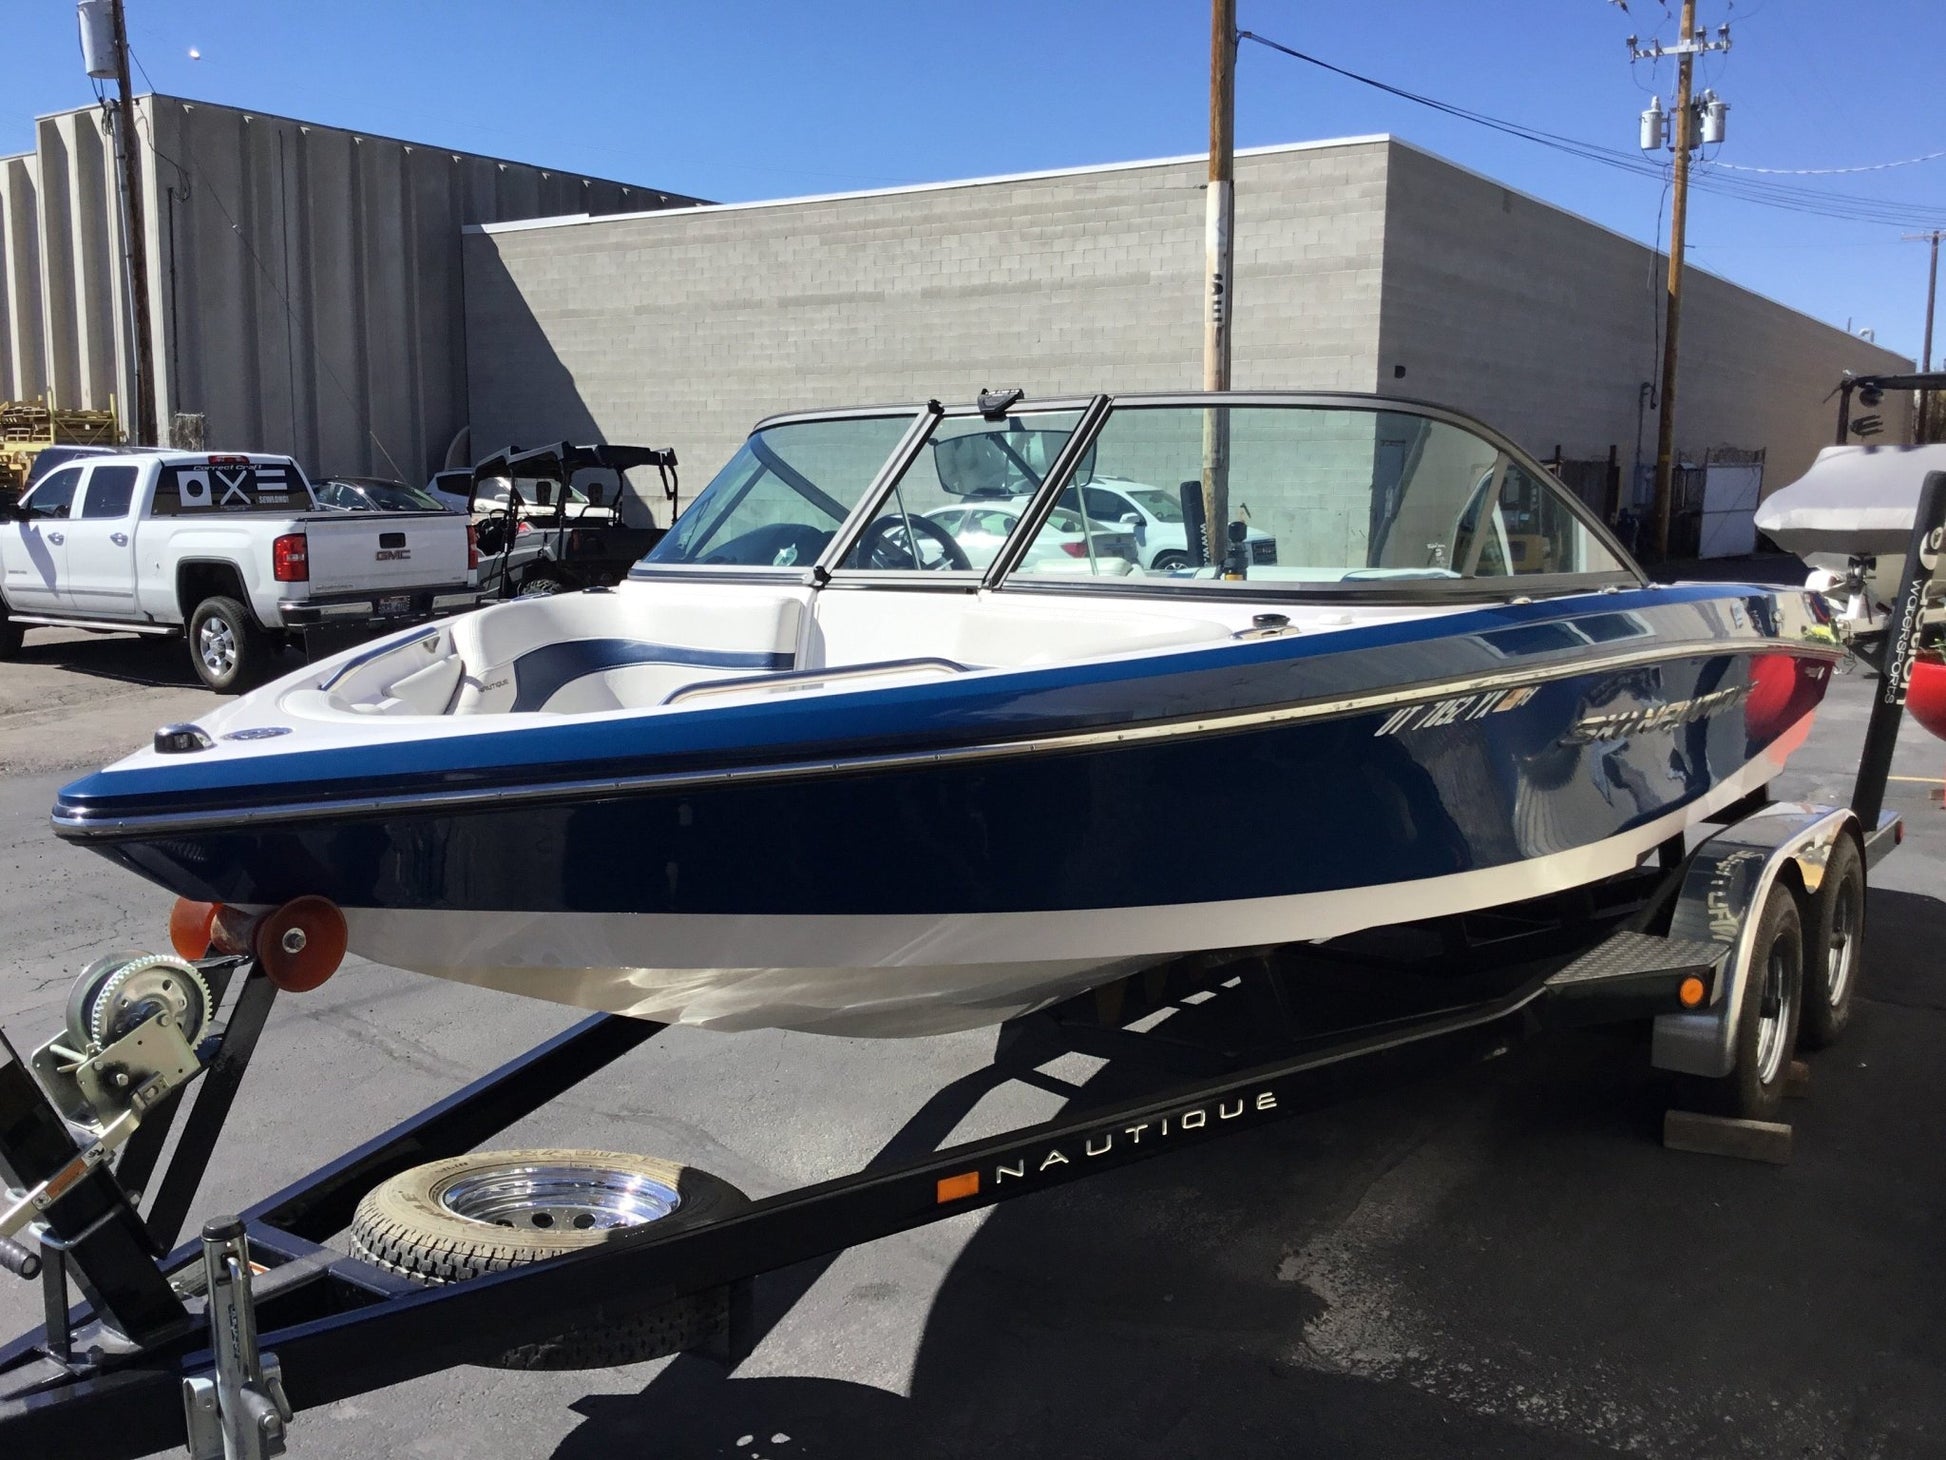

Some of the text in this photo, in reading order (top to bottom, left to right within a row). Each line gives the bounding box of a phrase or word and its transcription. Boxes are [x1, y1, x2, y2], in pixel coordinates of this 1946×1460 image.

[375, 550, 411, 561] GMC
[1374, 705, 1425, 737] UT
[996, 1092, 1277, 1184] NAUTIQUE
